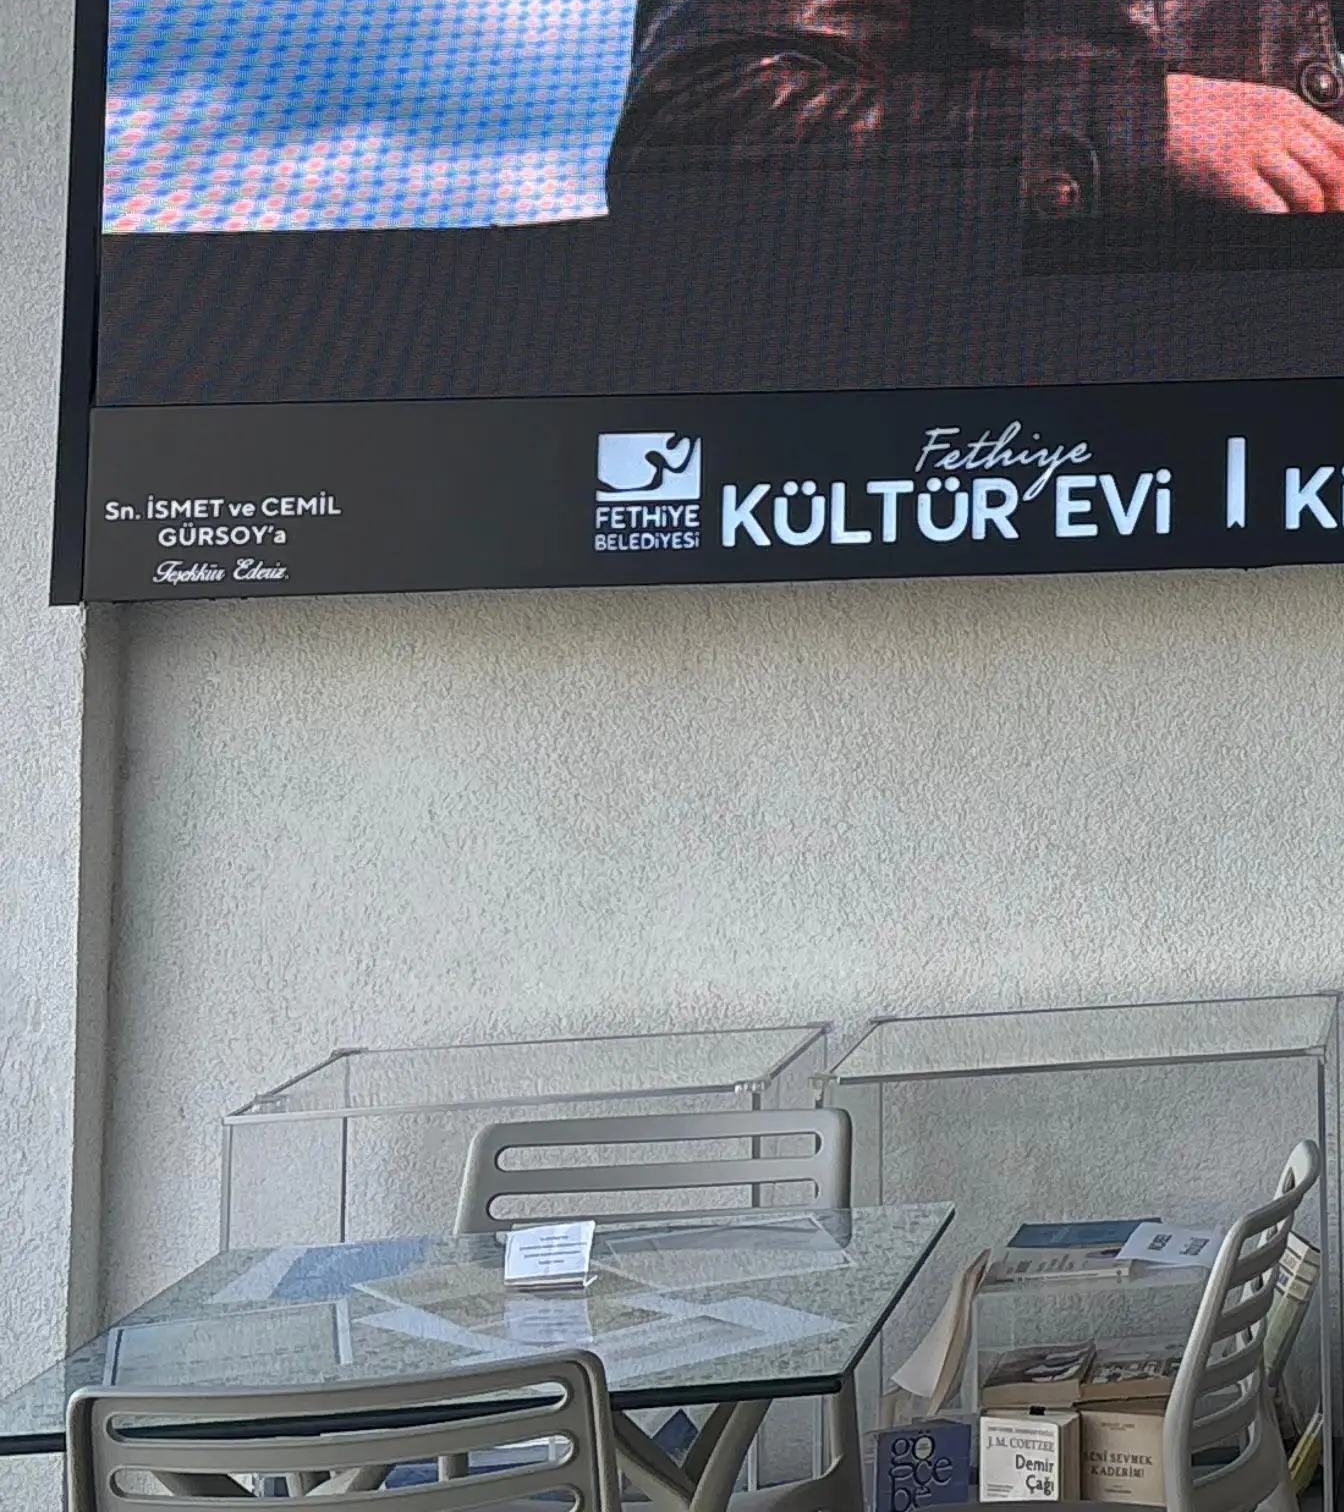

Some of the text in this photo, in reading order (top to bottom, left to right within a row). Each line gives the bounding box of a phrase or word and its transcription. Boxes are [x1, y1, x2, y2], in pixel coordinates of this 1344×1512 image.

[914, 420, 1092, 501] Fethiye
[105, 490, 342, 520] Sn. İSMET ve CEMİL
[721, 477, 1019, 548] KÜLTÜR
[1009, 1437, 1055, 1453] COETZEE
[1015, 1454, 1055, 1473] Demir
[1026, 1474, 1055, 1497] Çağı
